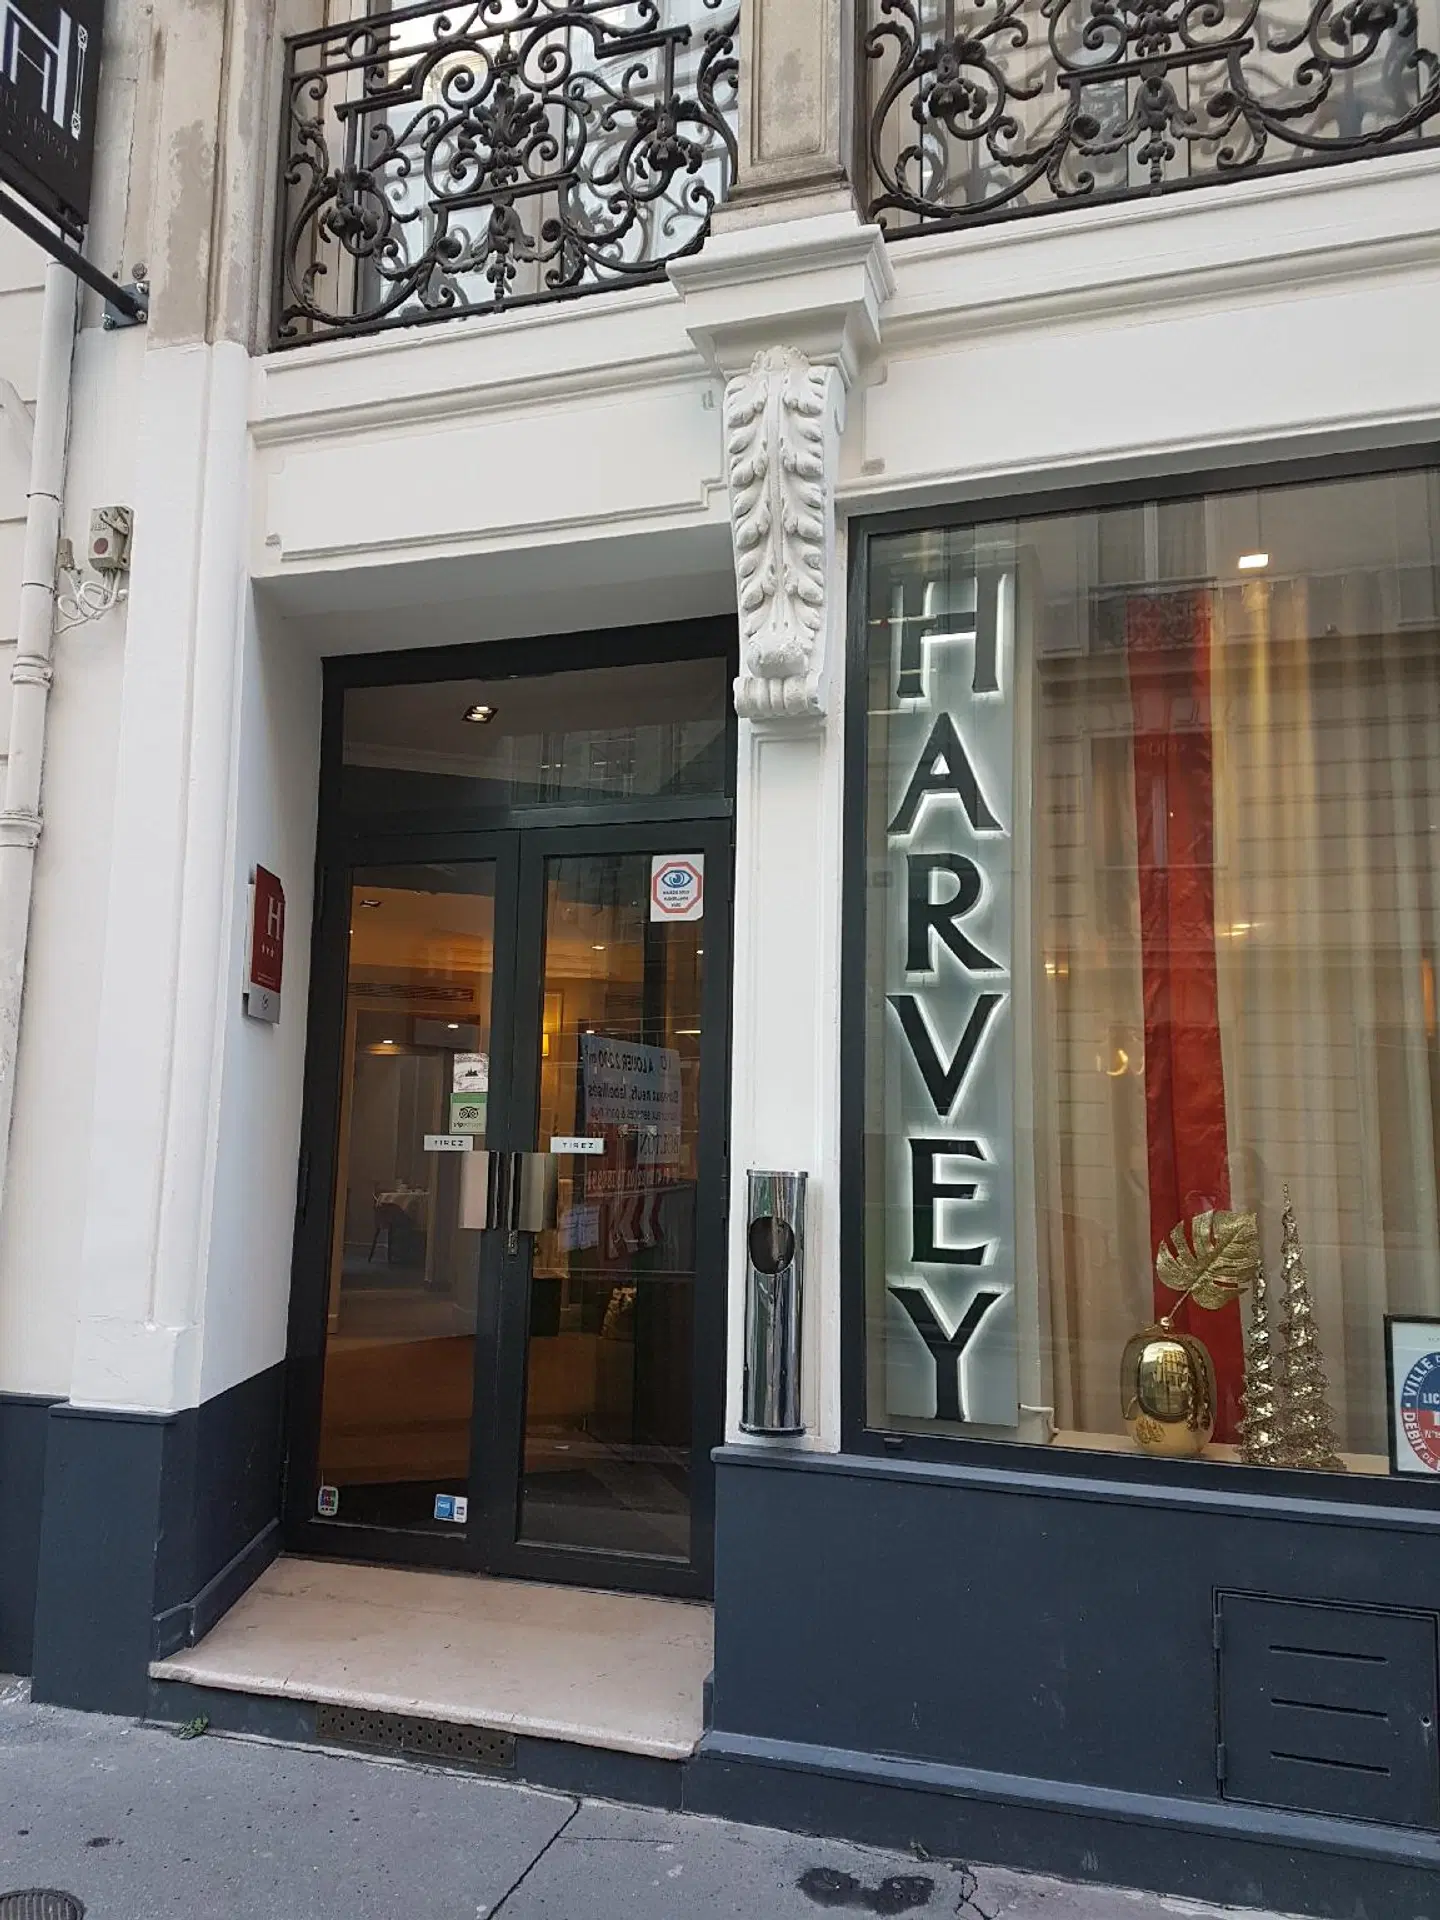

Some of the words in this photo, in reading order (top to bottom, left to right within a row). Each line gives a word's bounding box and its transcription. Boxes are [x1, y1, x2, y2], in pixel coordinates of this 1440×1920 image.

[885, 573, 1012, 1422] HARVEY
[434, 1139, 464, 1147] TIREZ
[562, 1141, 594, 1149] TIREZ
[1403, 1357, 1433, 1397] VILLE
[1402, 1412, 1428, 1452] DEBIT
